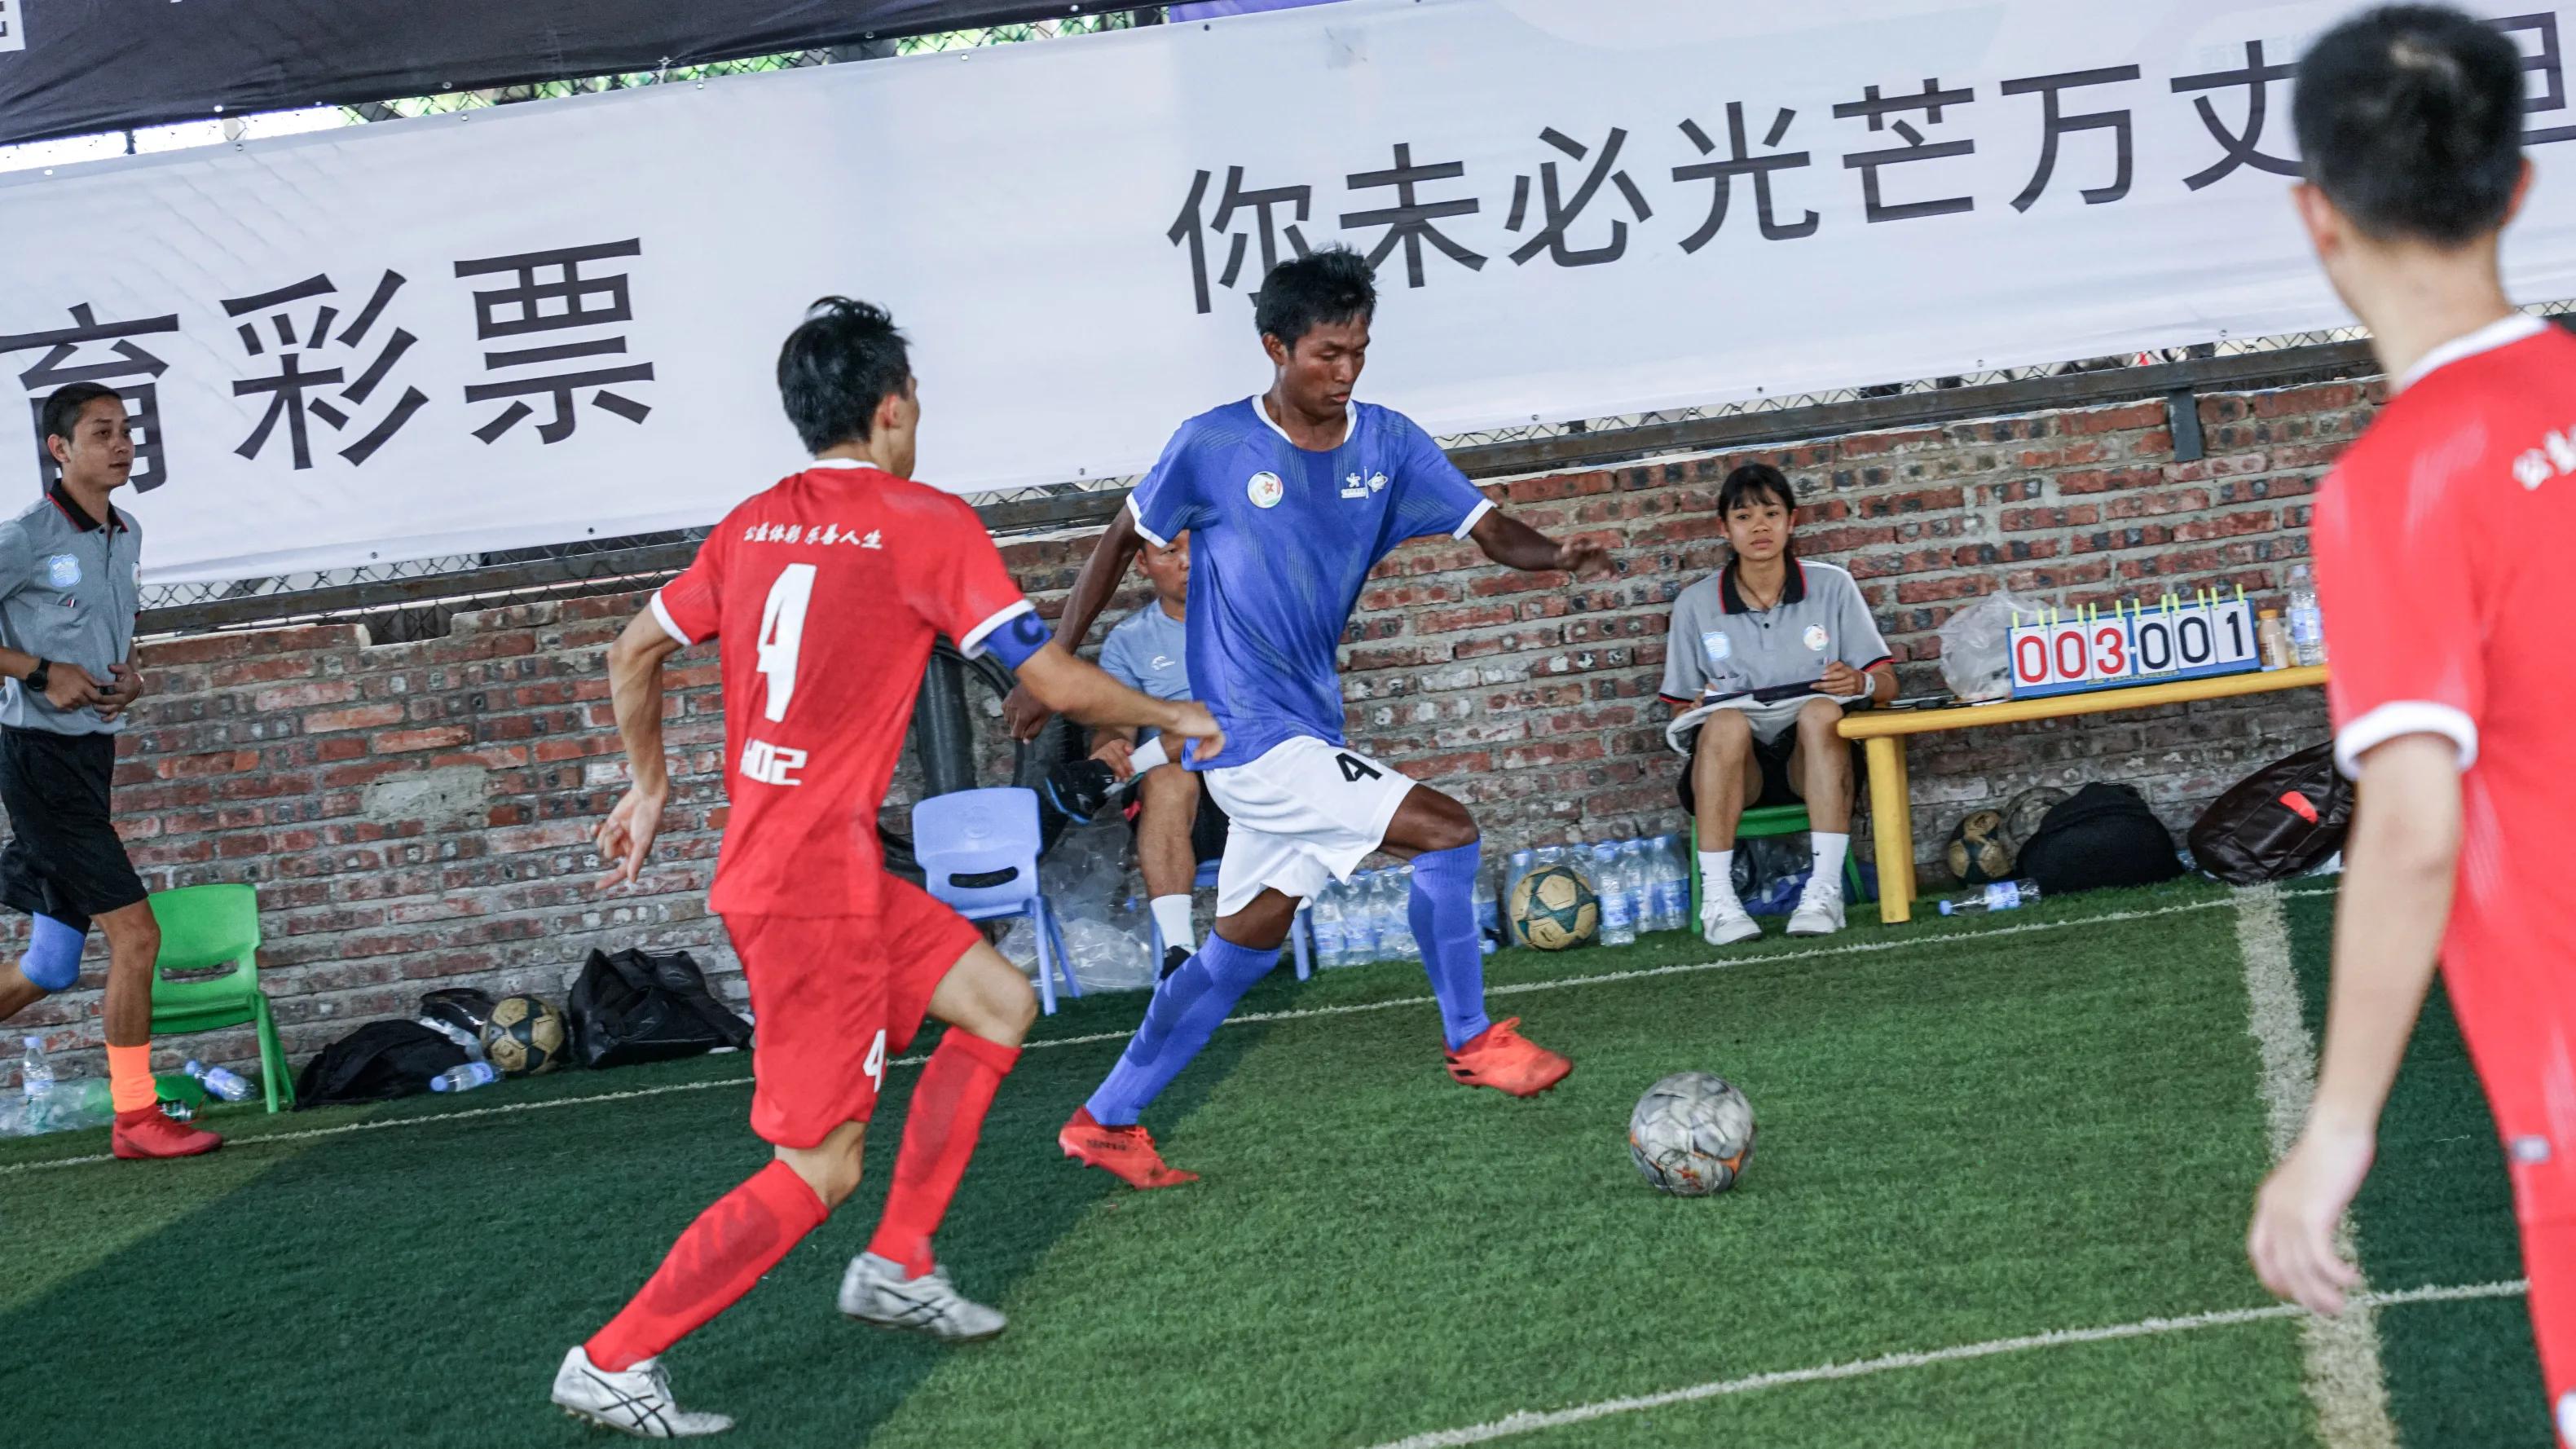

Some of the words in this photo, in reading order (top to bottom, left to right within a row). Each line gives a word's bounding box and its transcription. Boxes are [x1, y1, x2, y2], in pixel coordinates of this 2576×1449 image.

[1167, 40, 2310, 315] 你未必光芒万丈
[0, 237, 654, 495] 育彩票
[756, 562, 817, 723] 4
[1013, 614, 1044, 645] C
[2016, 627, 2125, 683] 003
[2139, 611, 2245, 670] 001
[1335, 752, 1382, 782] 4
[862, 1028, 886, 1093] 4
